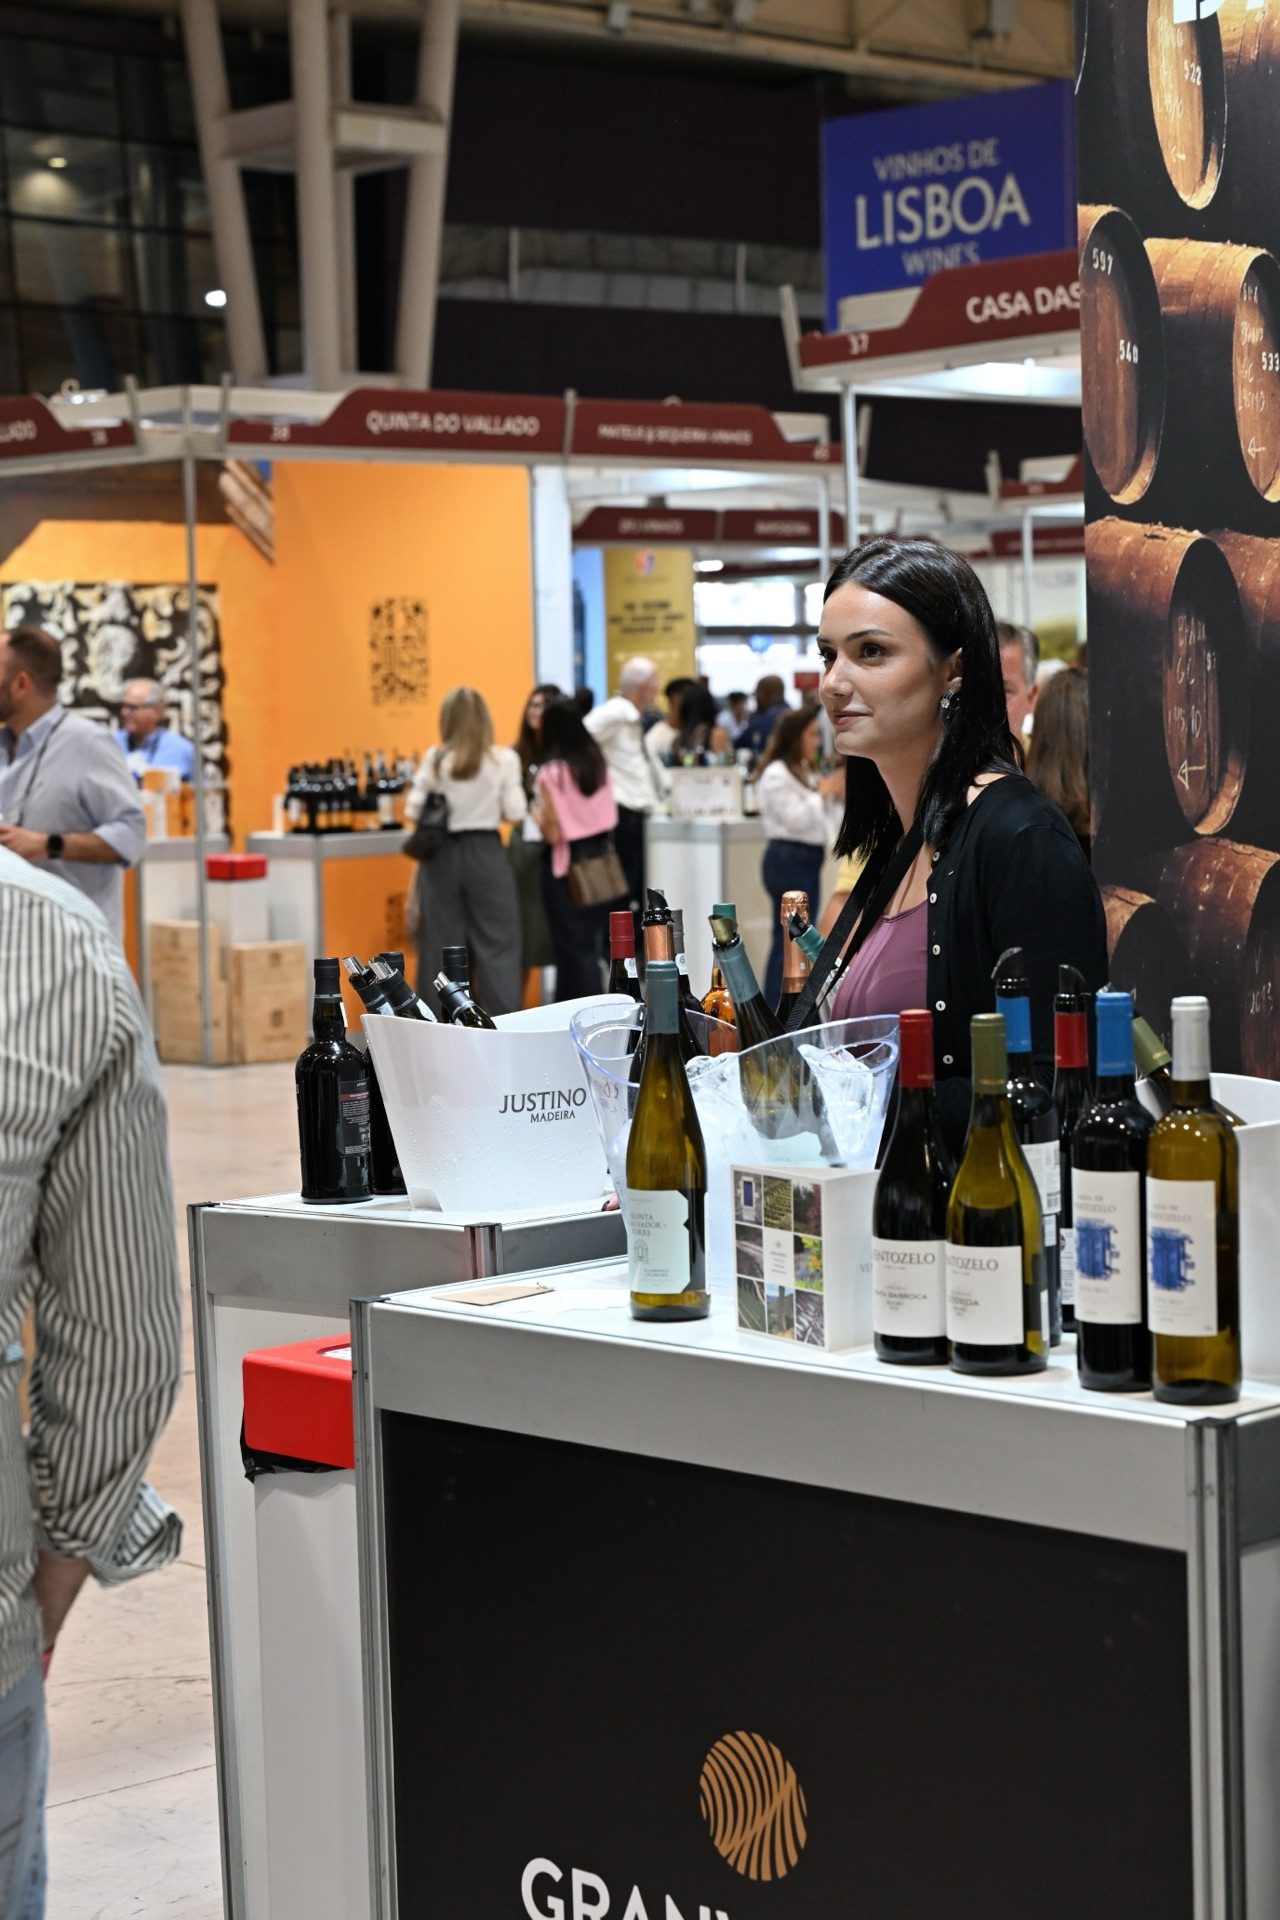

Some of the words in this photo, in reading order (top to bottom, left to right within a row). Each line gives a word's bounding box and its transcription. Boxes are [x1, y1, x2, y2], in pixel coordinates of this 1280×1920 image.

[1183, 59, 1202, 87] 522
[872, 142, 965, 183] VINHOS
[966, 137, 999, 170] DE
[855, 171, 1031, 250] LISBOA
[1092, 247, 1114, 276] 597
[965, 290, 1033, 324] CASA
[847, 332, 869, 356] 37
[365, 409, 433, 435] QUINTA
[433, 411, 461, 435] DO
[462, 413, 541, 437] VALLADO
[498, 1087, 587, 1114] JUSTINO
[530, 1109, 576, 1123] MADEIRA
